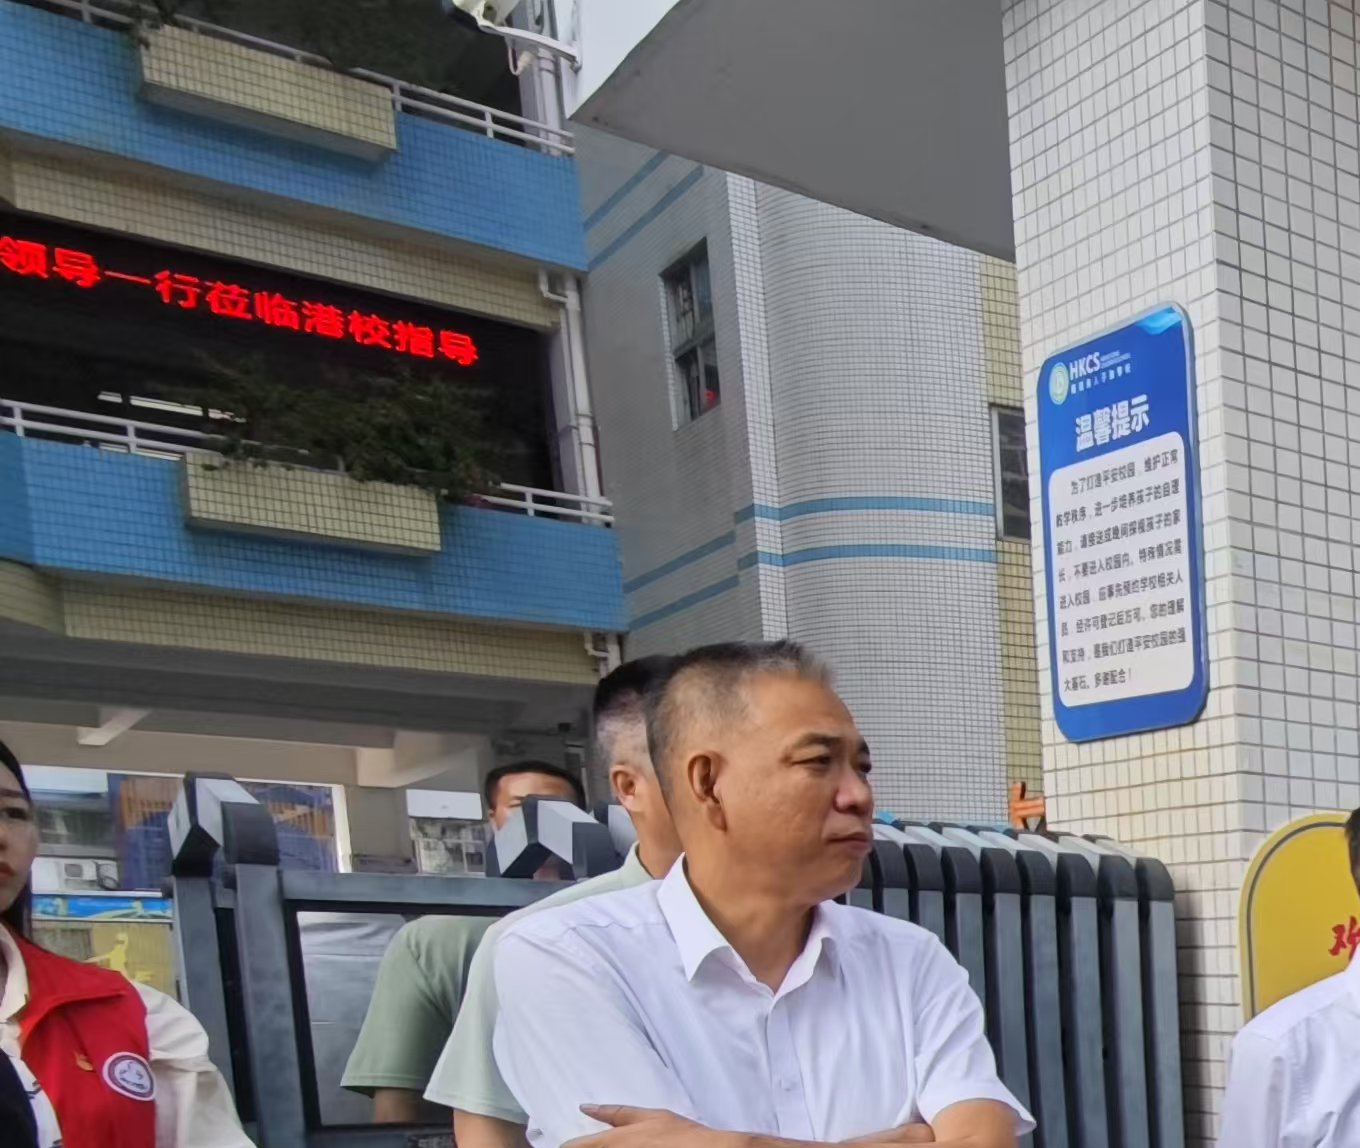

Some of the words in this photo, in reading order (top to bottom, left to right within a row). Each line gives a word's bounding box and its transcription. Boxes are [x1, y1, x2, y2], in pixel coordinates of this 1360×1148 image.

[0, 236, 478, 366] 领导一行莅临港校指导
[1069, 352, 1100, 381] HKCS
[1075, 394, 1150, 452] 温馨提示
